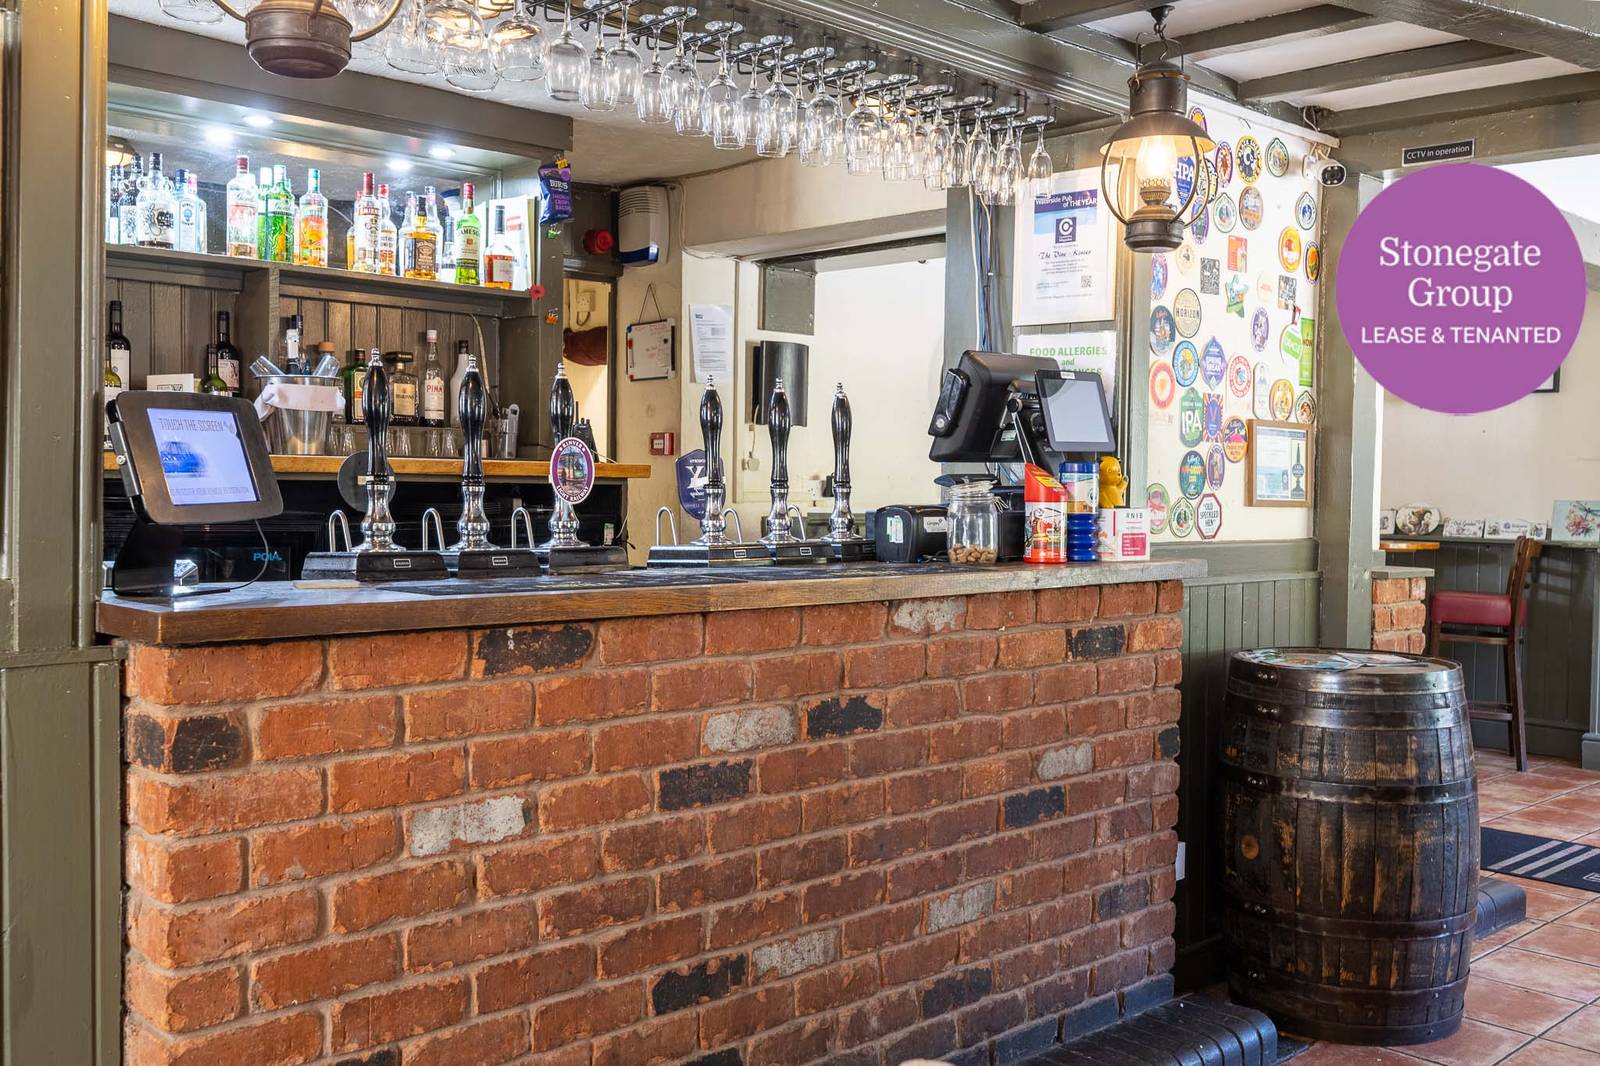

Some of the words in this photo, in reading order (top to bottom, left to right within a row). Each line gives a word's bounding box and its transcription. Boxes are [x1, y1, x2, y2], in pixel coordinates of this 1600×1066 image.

[1407, 150, 1427, 160] CCTV
[1435, 145, 1470, 157] operation
[1062, 195, 1073, 203] Pub
[1082, 198, 1097, 206] YEAR
[1176, 307, 1200, 318] HORIZON
[1029, 347, 1056, 356] FOOD
[1057, 346, 1107, 356] ALLERGIES
[1061, 358, 1075, 366] and
[159, 418, 184, 431] TOUCH
[184, 419, 198, 431] THE
[198, 419, 224, 432] SCREEN
[1181, 408, 1203, 435] IPA
[562, 440, 583, 448] KINVER
[556, 485, 570, 500] LIGHT
[569, 486, 589, 501] RAILWAY
